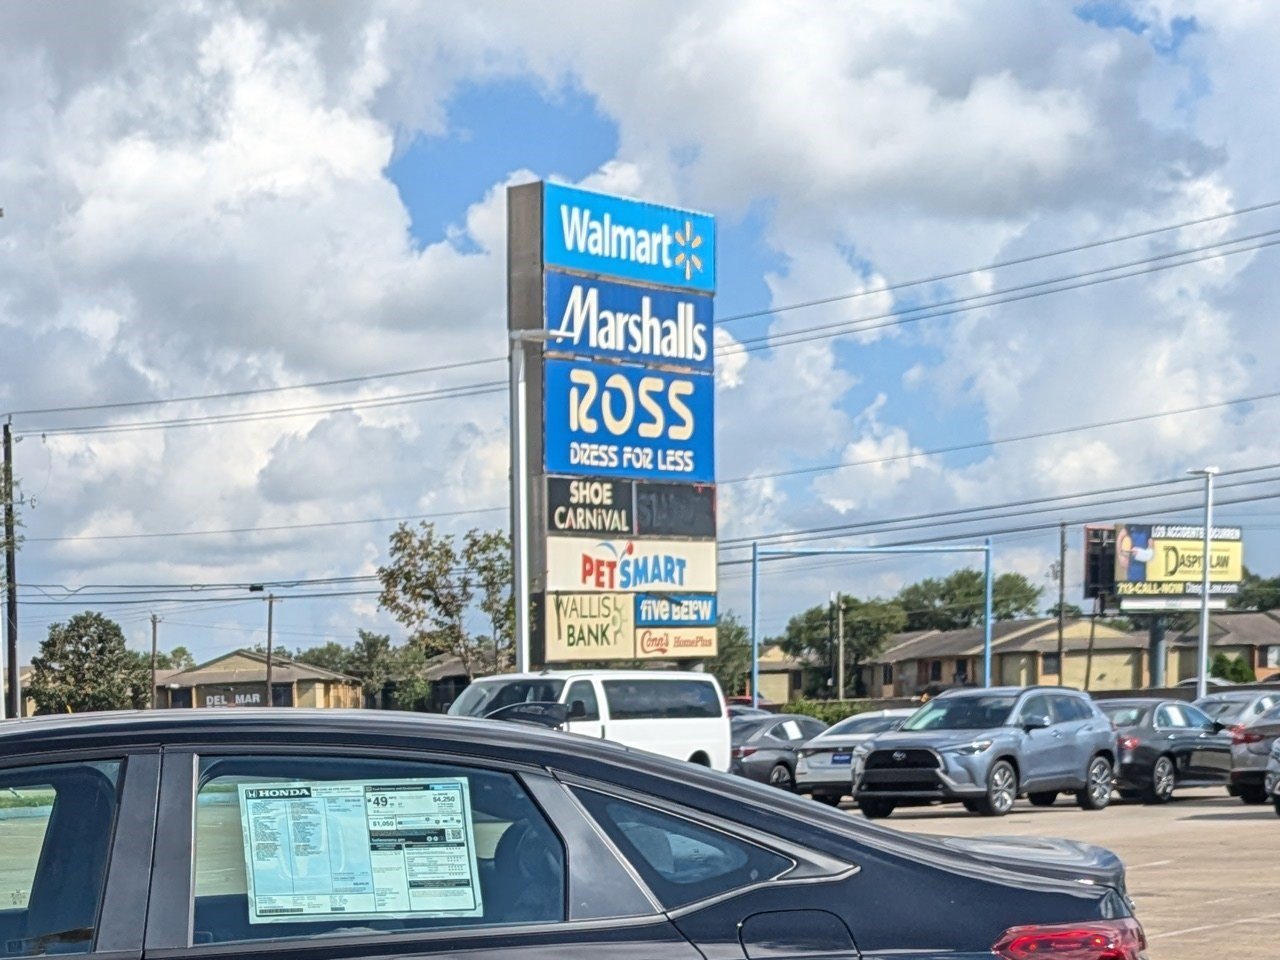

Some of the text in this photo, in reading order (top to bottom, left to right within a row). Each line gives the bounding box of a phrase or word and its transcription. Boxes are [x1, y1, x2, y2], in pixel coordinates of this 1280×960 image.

[560, 204, 673, 268] Walmart
[551, 285, 707, 361] Marshalls
[569, 368, 694, 440] ROSS
[570, 441, 695, 472] DRESS FOR LESS
[569, 480, 613, 505] SHOE
[1163, 545, 1204, 577] DASPI
[553, 596, 611, 619] WALLIS
[640, 599, 670, 620] five
[567, 624, 611, 647] BANK
[206, 693, 261, 706] DEL MAR
[258, 788, 311, 797] HONDA
[372, 796, 388, 807] 49
